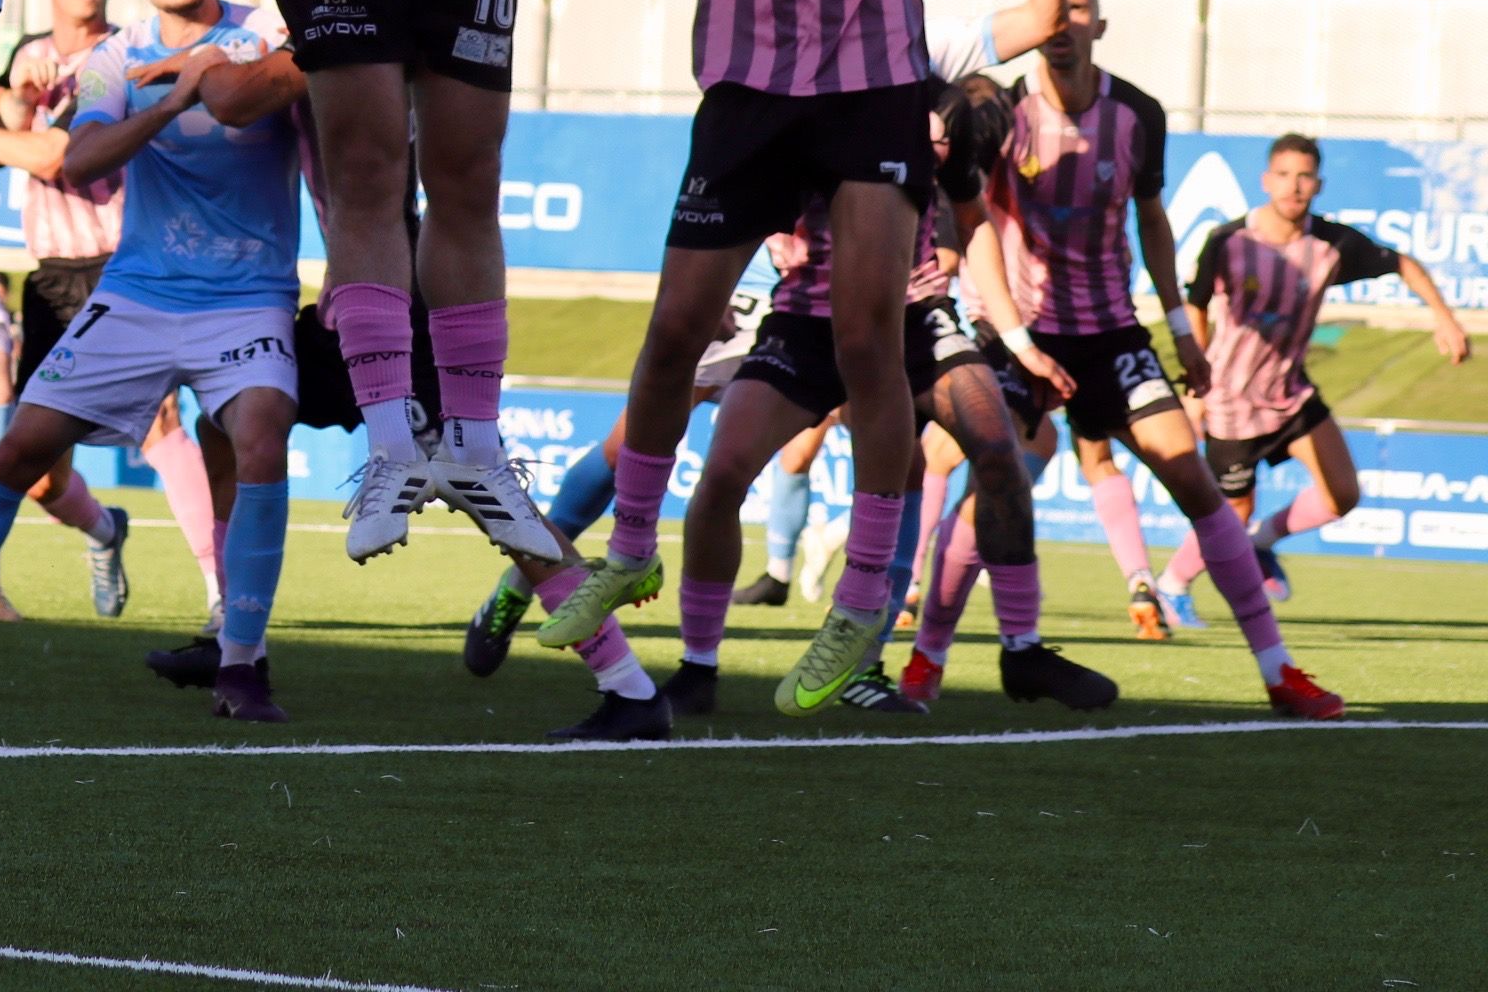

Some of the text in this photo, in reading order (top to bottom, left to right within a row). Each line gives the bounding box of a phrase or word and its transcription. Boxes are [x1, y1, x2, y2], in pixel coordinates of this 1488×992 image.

[304, 22, 377, 40] GIVOVA
[880, 161, 907, 185] 7
[73, 302, 111, 339] 7
[924, 308, 957, 337] 3
[1115, 349, 1162, 388] 23
